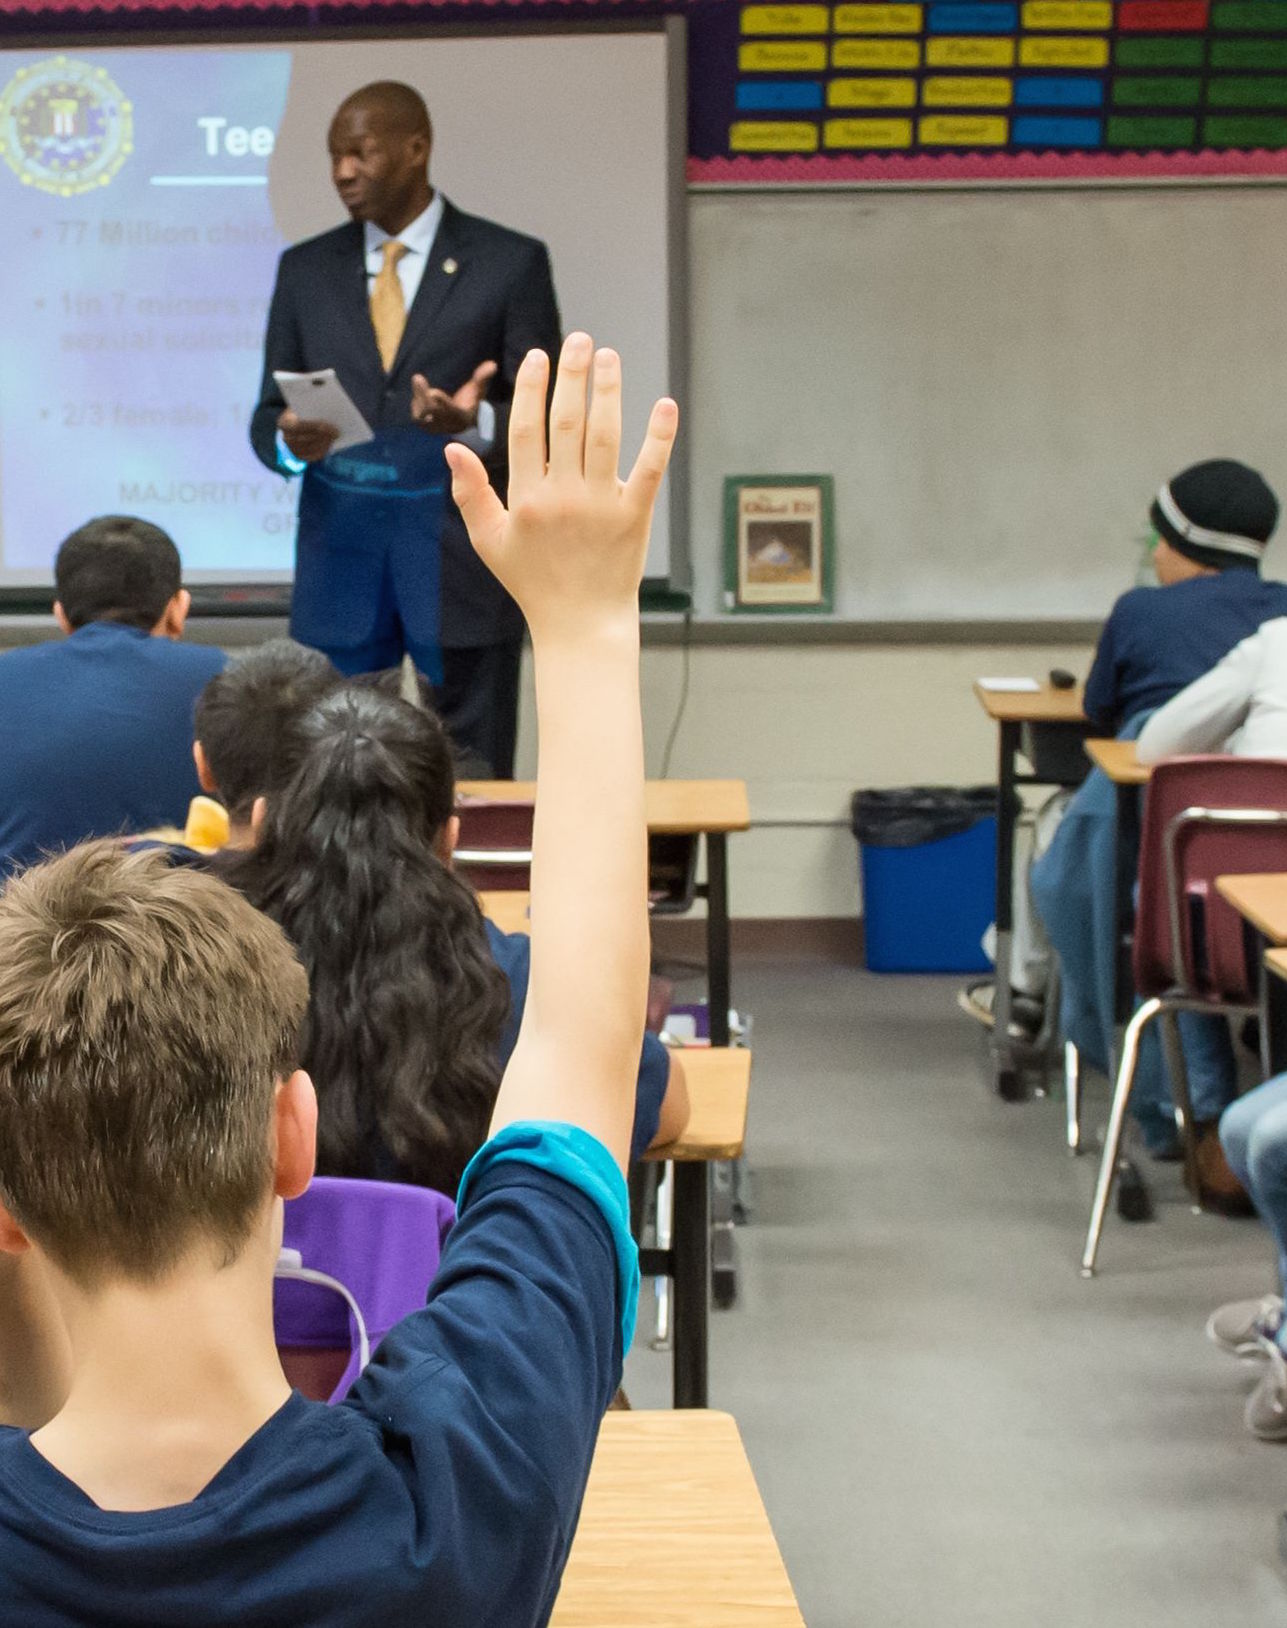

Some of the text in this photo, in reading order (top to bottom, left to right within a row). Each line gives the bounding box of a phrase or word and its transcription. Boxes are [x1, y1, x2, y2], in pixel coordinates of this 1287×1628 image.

[197, 116, 275, 157] Tee
[99, 219, 199, 245] Million
[119, 481, 262, 504] MAJORITY
